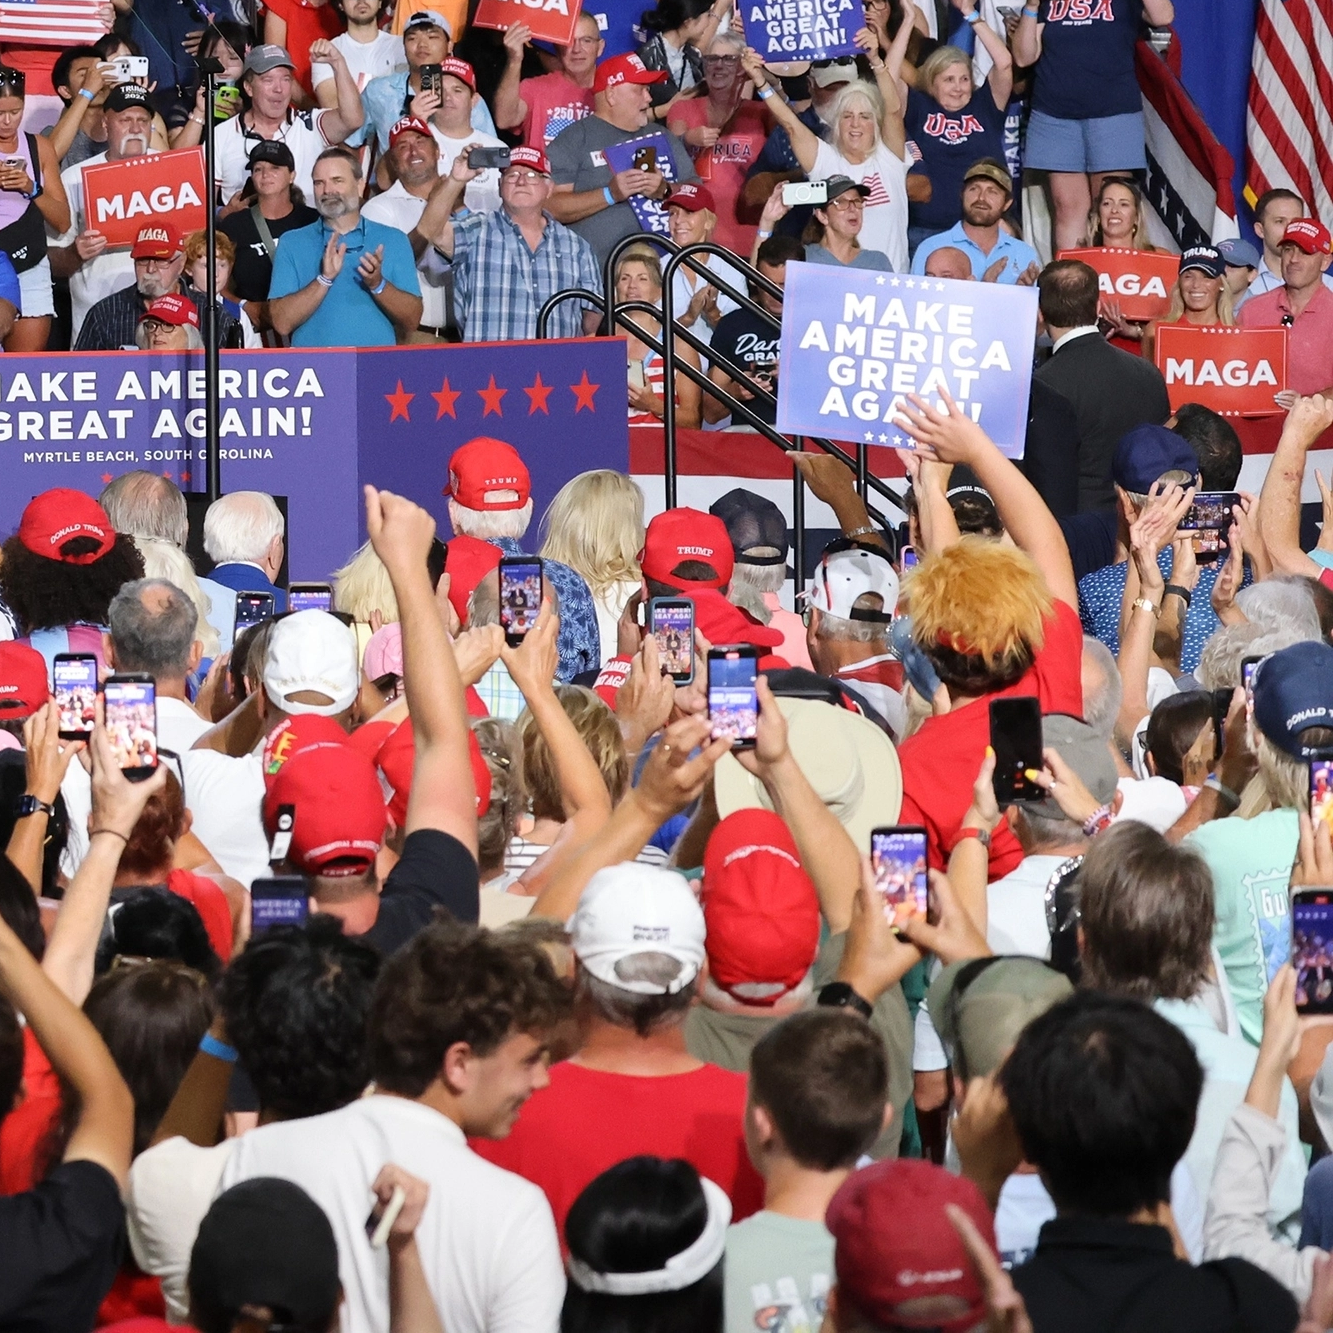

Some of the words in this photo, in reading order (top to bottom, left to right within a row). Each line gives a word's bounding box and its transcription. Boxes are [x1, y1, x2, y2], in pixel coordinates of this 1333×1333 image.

[766, 13, 842, 37] GREAT
[767, 28, 847, 53] AGAIN!
[120, 85, 148, 94] TRUMP
[392, 117, 425, 135] USA
[554, 108, 573, 120] 250
[96, 181, 202, 223] MAGA
[137, 227, 170, 243] MAGA
[1183, 246, 1219, 260] TRUMP
[1098, 273, 1168, 299] AGA
[843, 292, 973, 336] MAKE
[798, 319, 1012, 372] AMERICA
[827, 357, 980, 401] GREAT
[1166, 358, 1278, 386] MAGA
[115, 368, 325, 401] AMERICA
[151, 407, 312, 439] AGAIN!
[23, 450, 82, 464] MYRTLE
[86, 449, 139, 466] BEACH,
[144, 448, 193, 462] SOUTH
[197, 447, 274, 460] CROLINA
[485, 477, 518, 486] TRUMP
[50, 524, 81, 544] DONALD
[83, 524, 105, 537] TRUMP
[677, 546, 714, 558] TRUMP
[1286, 707, 1327, 731] DONALD
